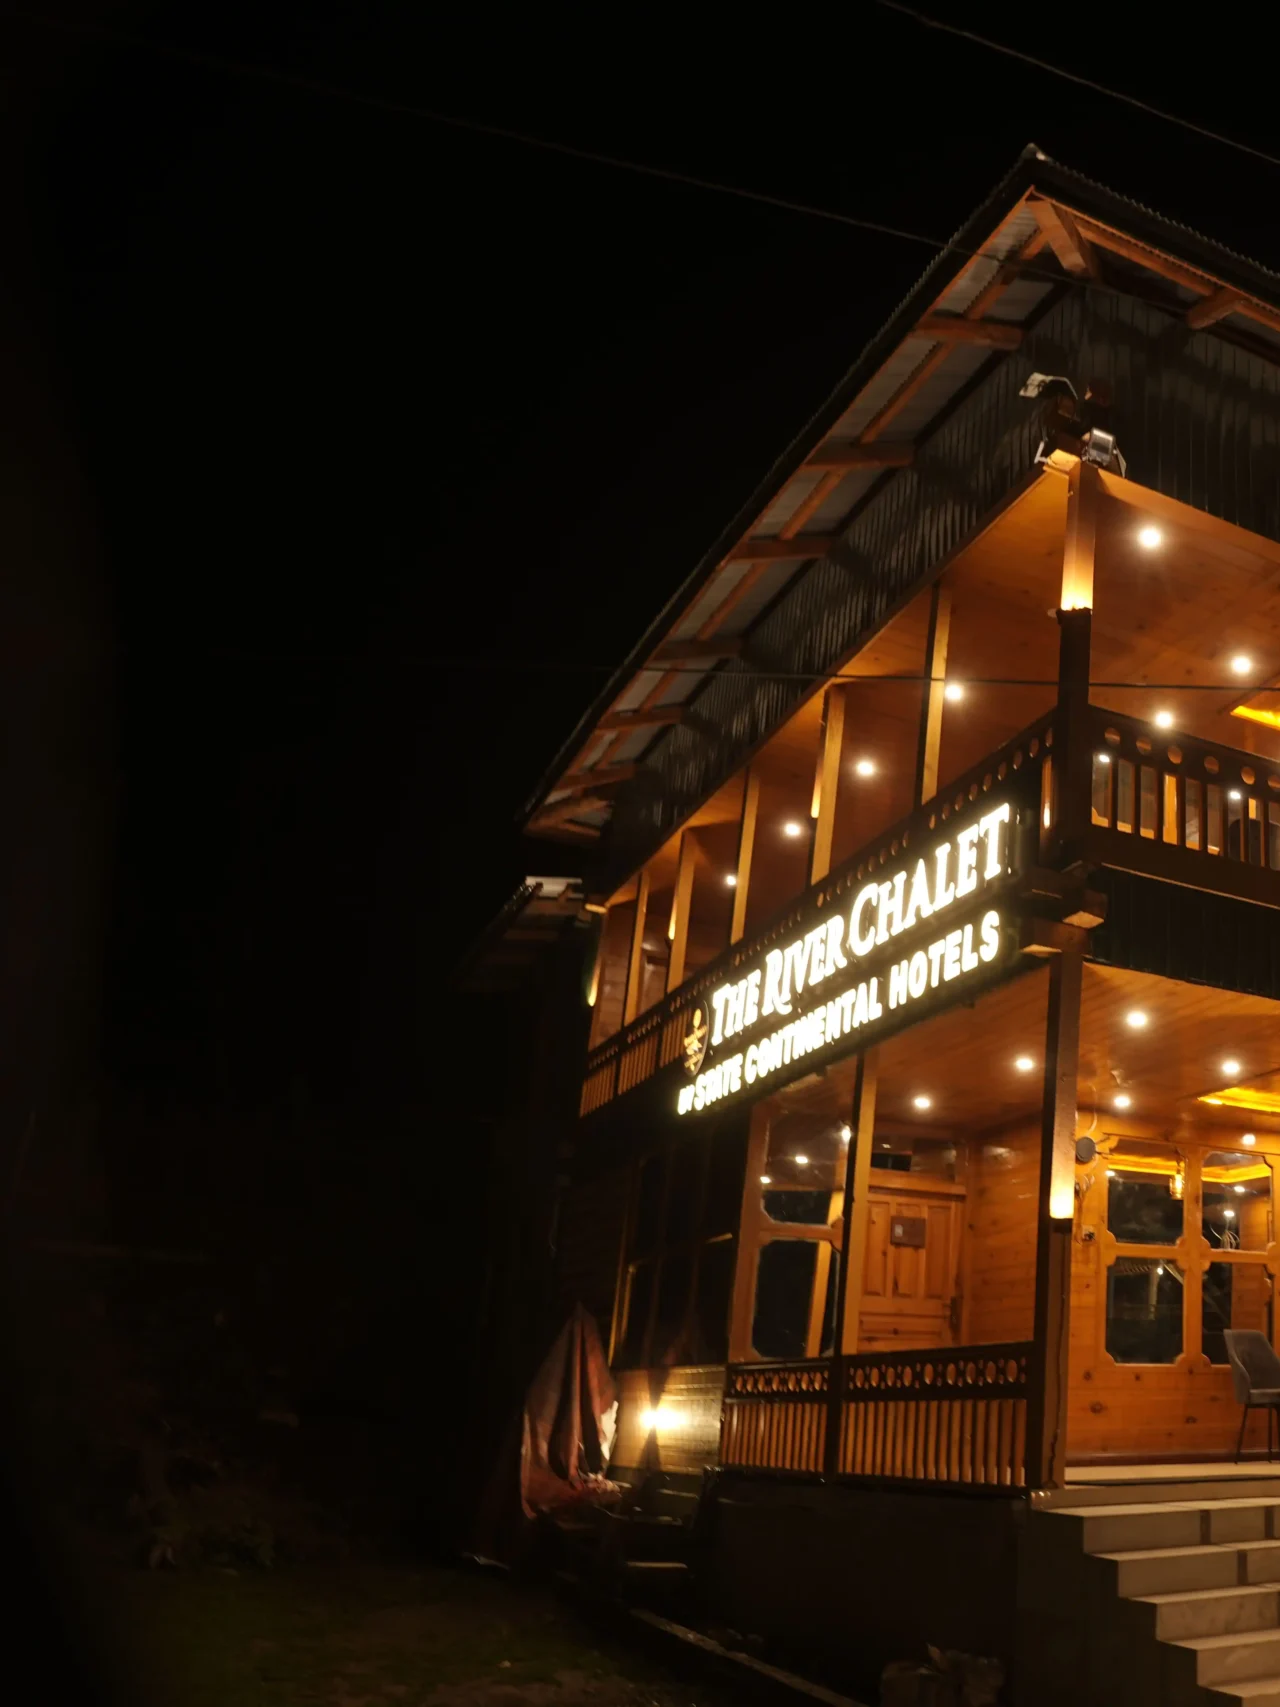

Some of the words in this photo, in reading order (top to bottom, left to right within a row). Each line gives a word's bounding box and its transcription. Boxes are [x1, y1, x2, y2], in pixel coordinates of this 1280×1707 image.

[693, 1053, 744, 1111] STATE
[744, 977, 883, 1084] CONTINENTAL
[888, 910, 1000, 1010] HOTELS
[711, 968, 762, 1046] THE
[761, 915, 848, 1016] RIVER
[847, 802, 1010, 957] CHALET
